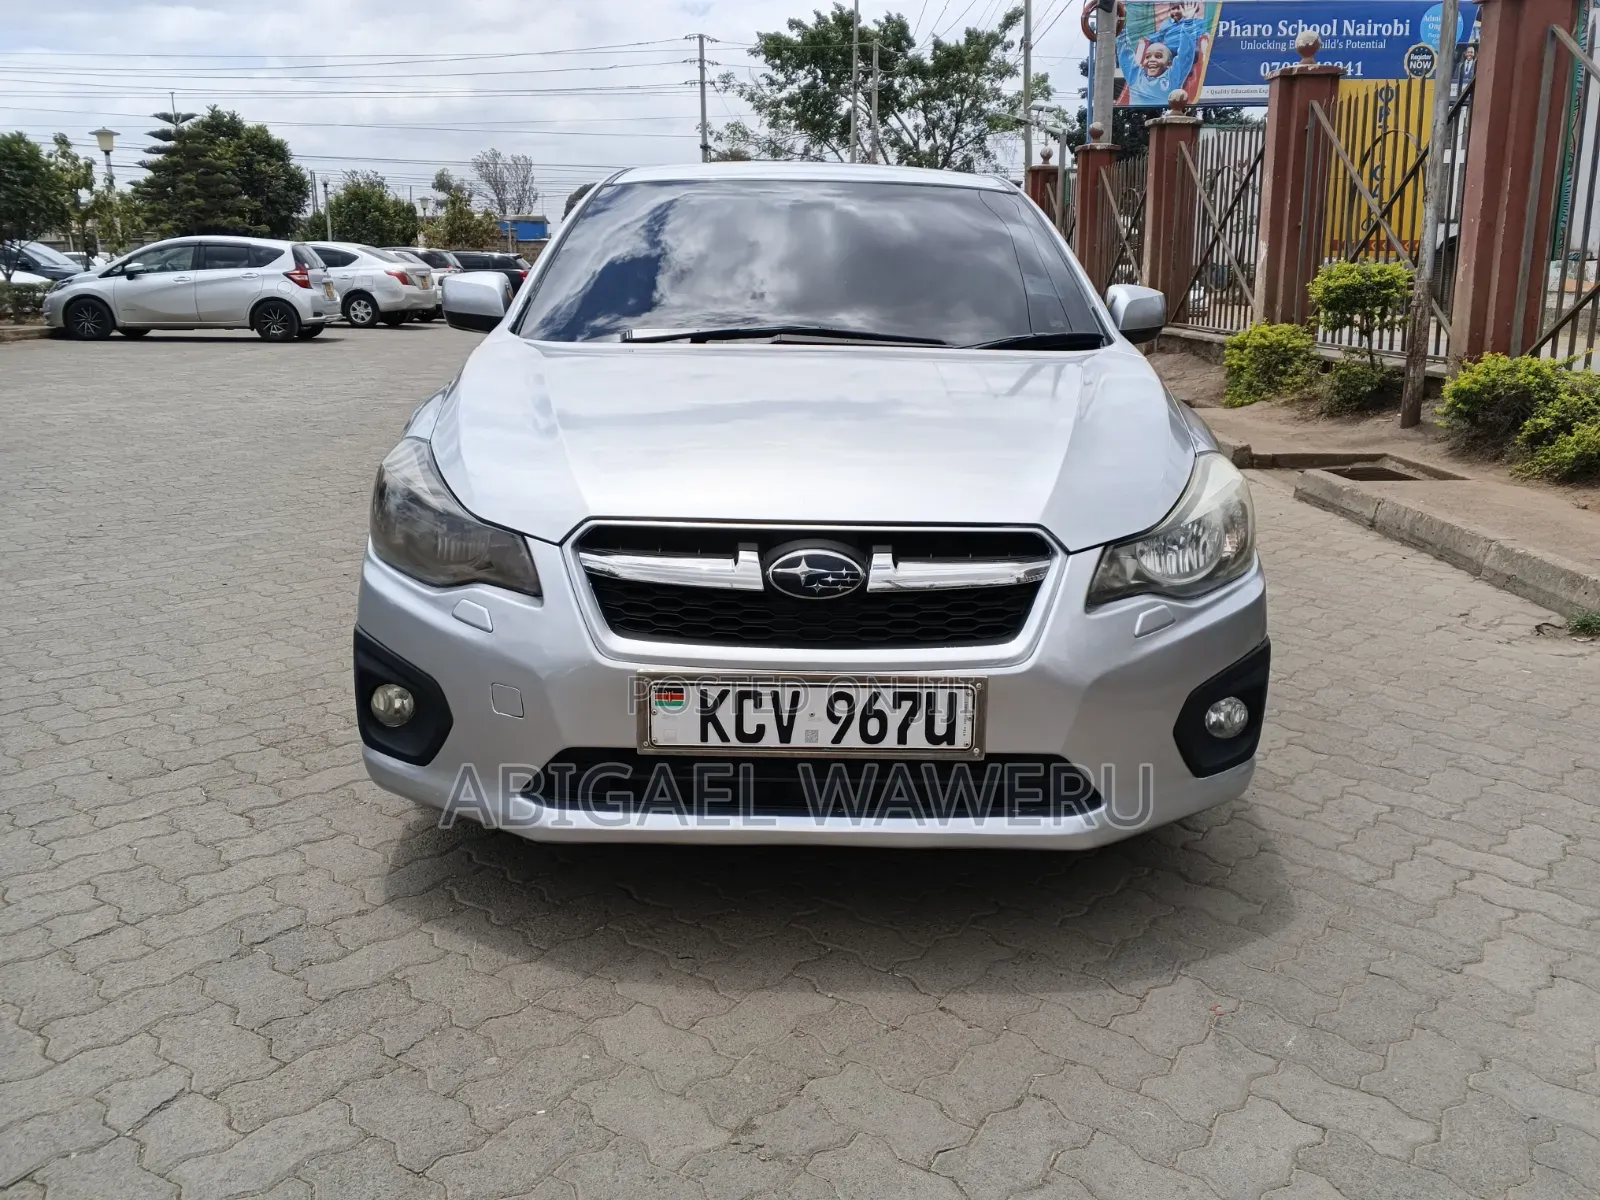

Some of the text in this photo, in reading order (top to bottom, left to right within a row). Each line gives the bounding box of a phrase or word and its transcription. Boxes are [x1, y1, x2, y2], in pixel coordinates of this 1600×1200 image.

[1217, 20, 1273, 37] Pharo
[1277, 19, 1338, 37] School
[1342, 18, 1411, 37] Nairobi
[1240, 40, 1287, 51] Unlocking
[1345, 39, 1386, 49] Potential
[1409, 53, 1432, 69] Register NOW
[700, 688, 801, 744] KCV
[826, 690, 958, 746] 967U
